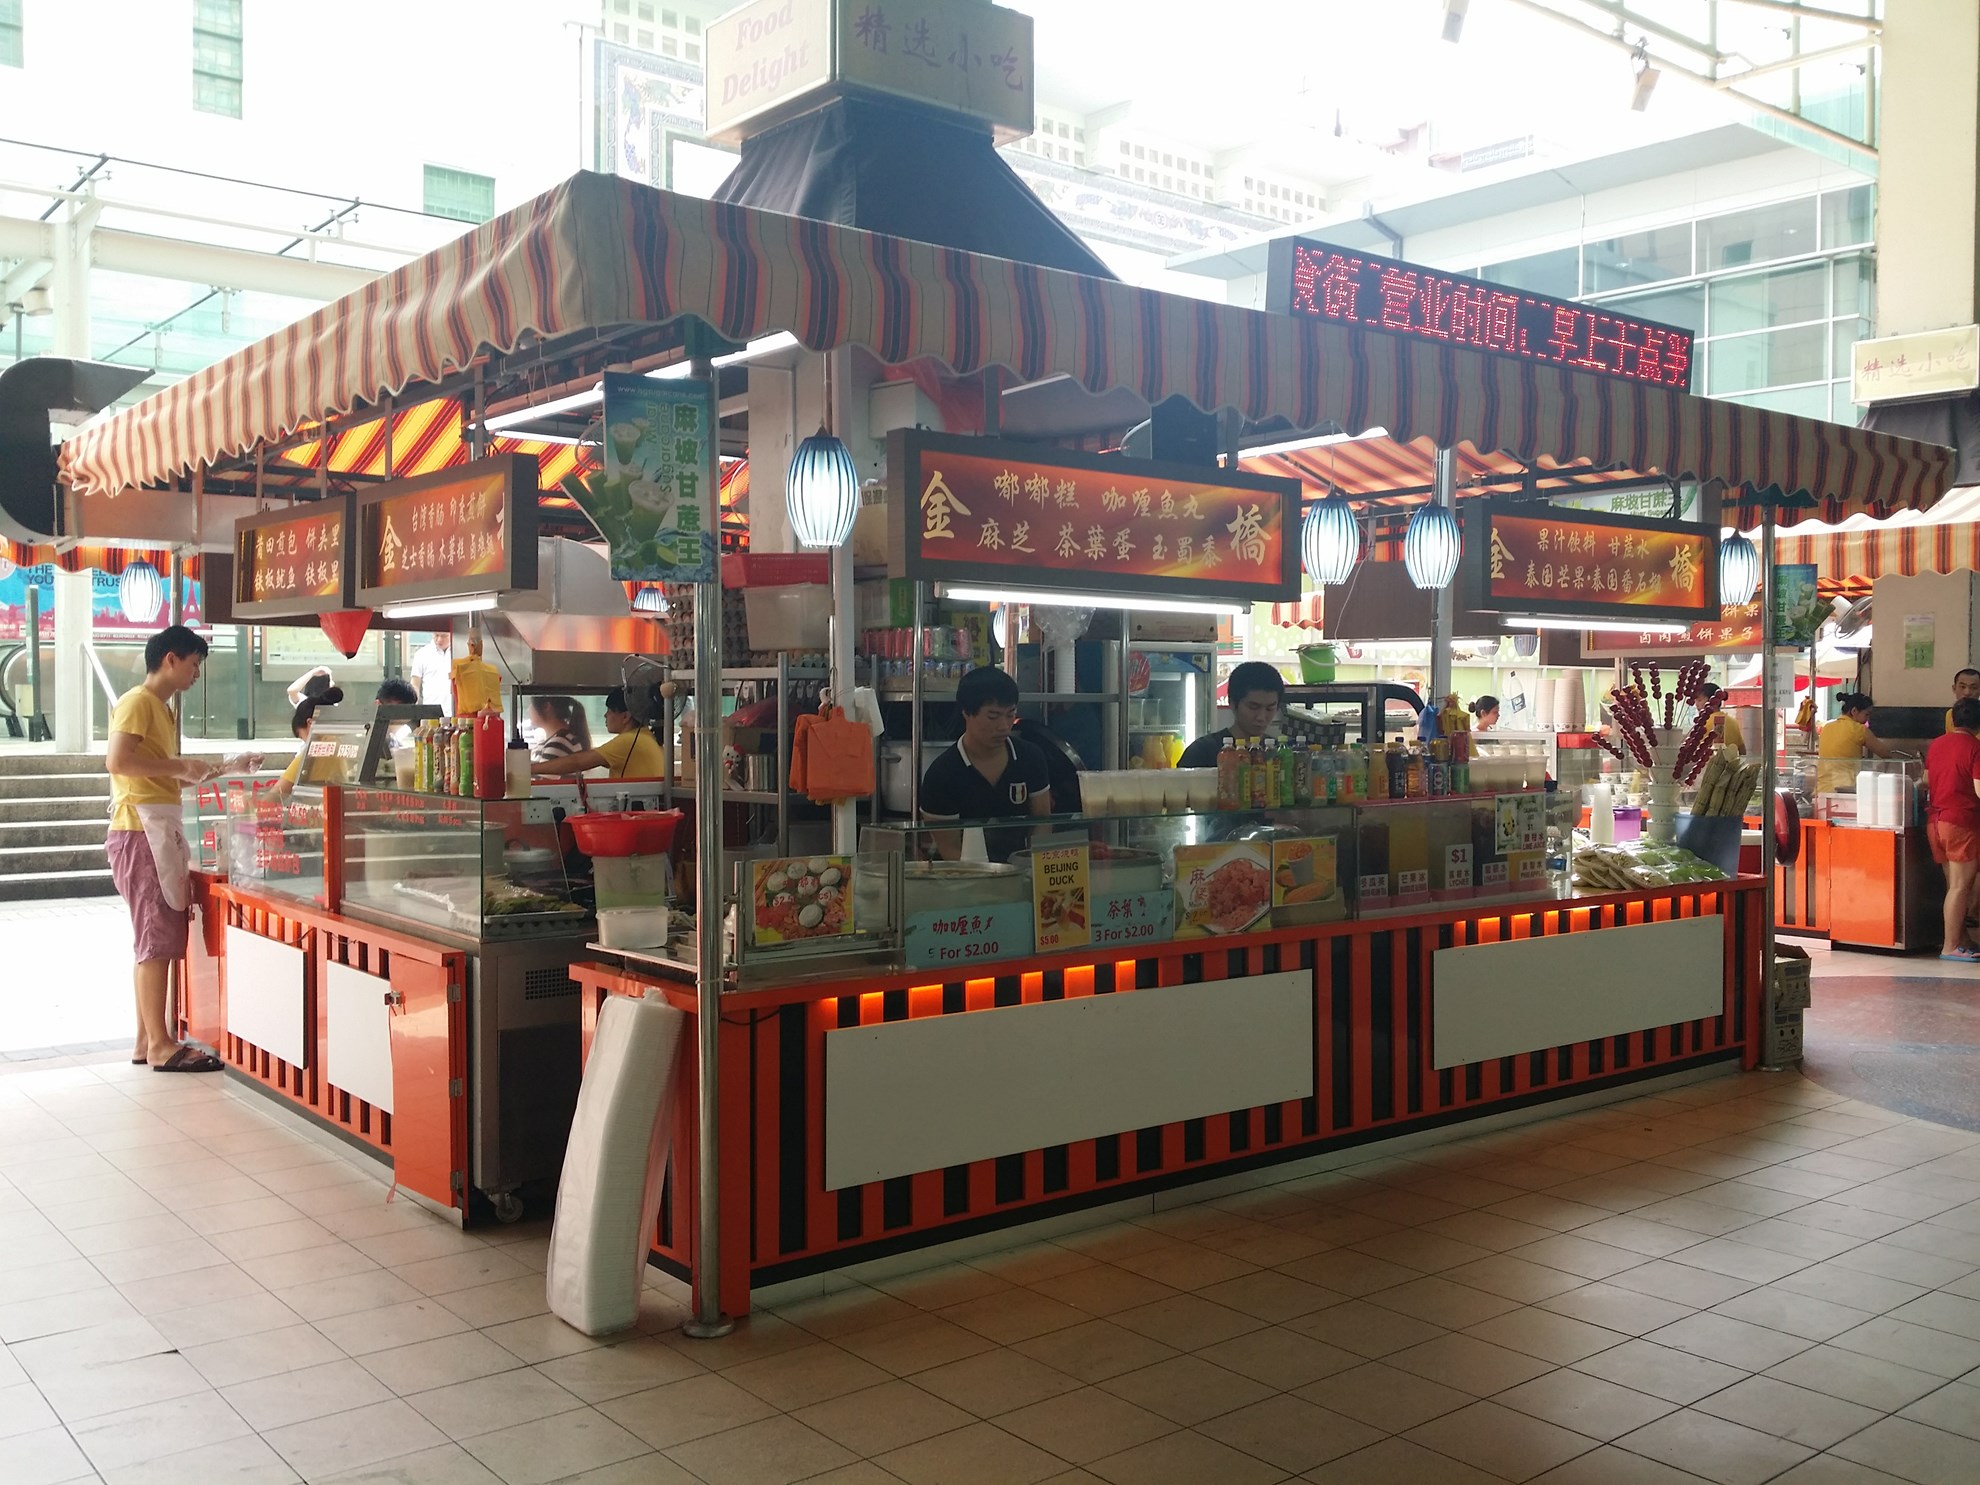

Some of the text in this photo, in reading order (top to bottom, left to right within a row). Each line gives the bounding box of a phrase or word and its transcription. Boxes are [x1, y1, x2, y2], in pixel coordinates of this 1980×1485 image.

[735, 1, 794, 51] Food
[854, 7, 1023, 92] 精选小吃
[722, 39, 809, 105] Delight
[1862, 346, 1970, 382] 精选小吃
[673, 403, 702, 565] 麻坡甘蔗王
[920, 470, 972, 540] 金
[378, 515, 402, 572] 金
[1054, 523, 1136, 560] 茶葉蛋
[1226, 503, 1273, 566] 橋
[1490, 528, 1515, 580] 金
[1537, 527, 1597, 557] 果汁饮料
[1669, 543, 1698, 592] 橋
[1043, 861, 1079, 874] BEIJING
[1451, 848, 1468, 864] $1
[1049, 874, 1075, 886] DUCK
[940, 947, 961, 960] For
[964, 941, 999, 958] $2.00
[1040, 934, 1059, 946] $5.00
[1095, 923, 1154, 942] 3 For $2.00
